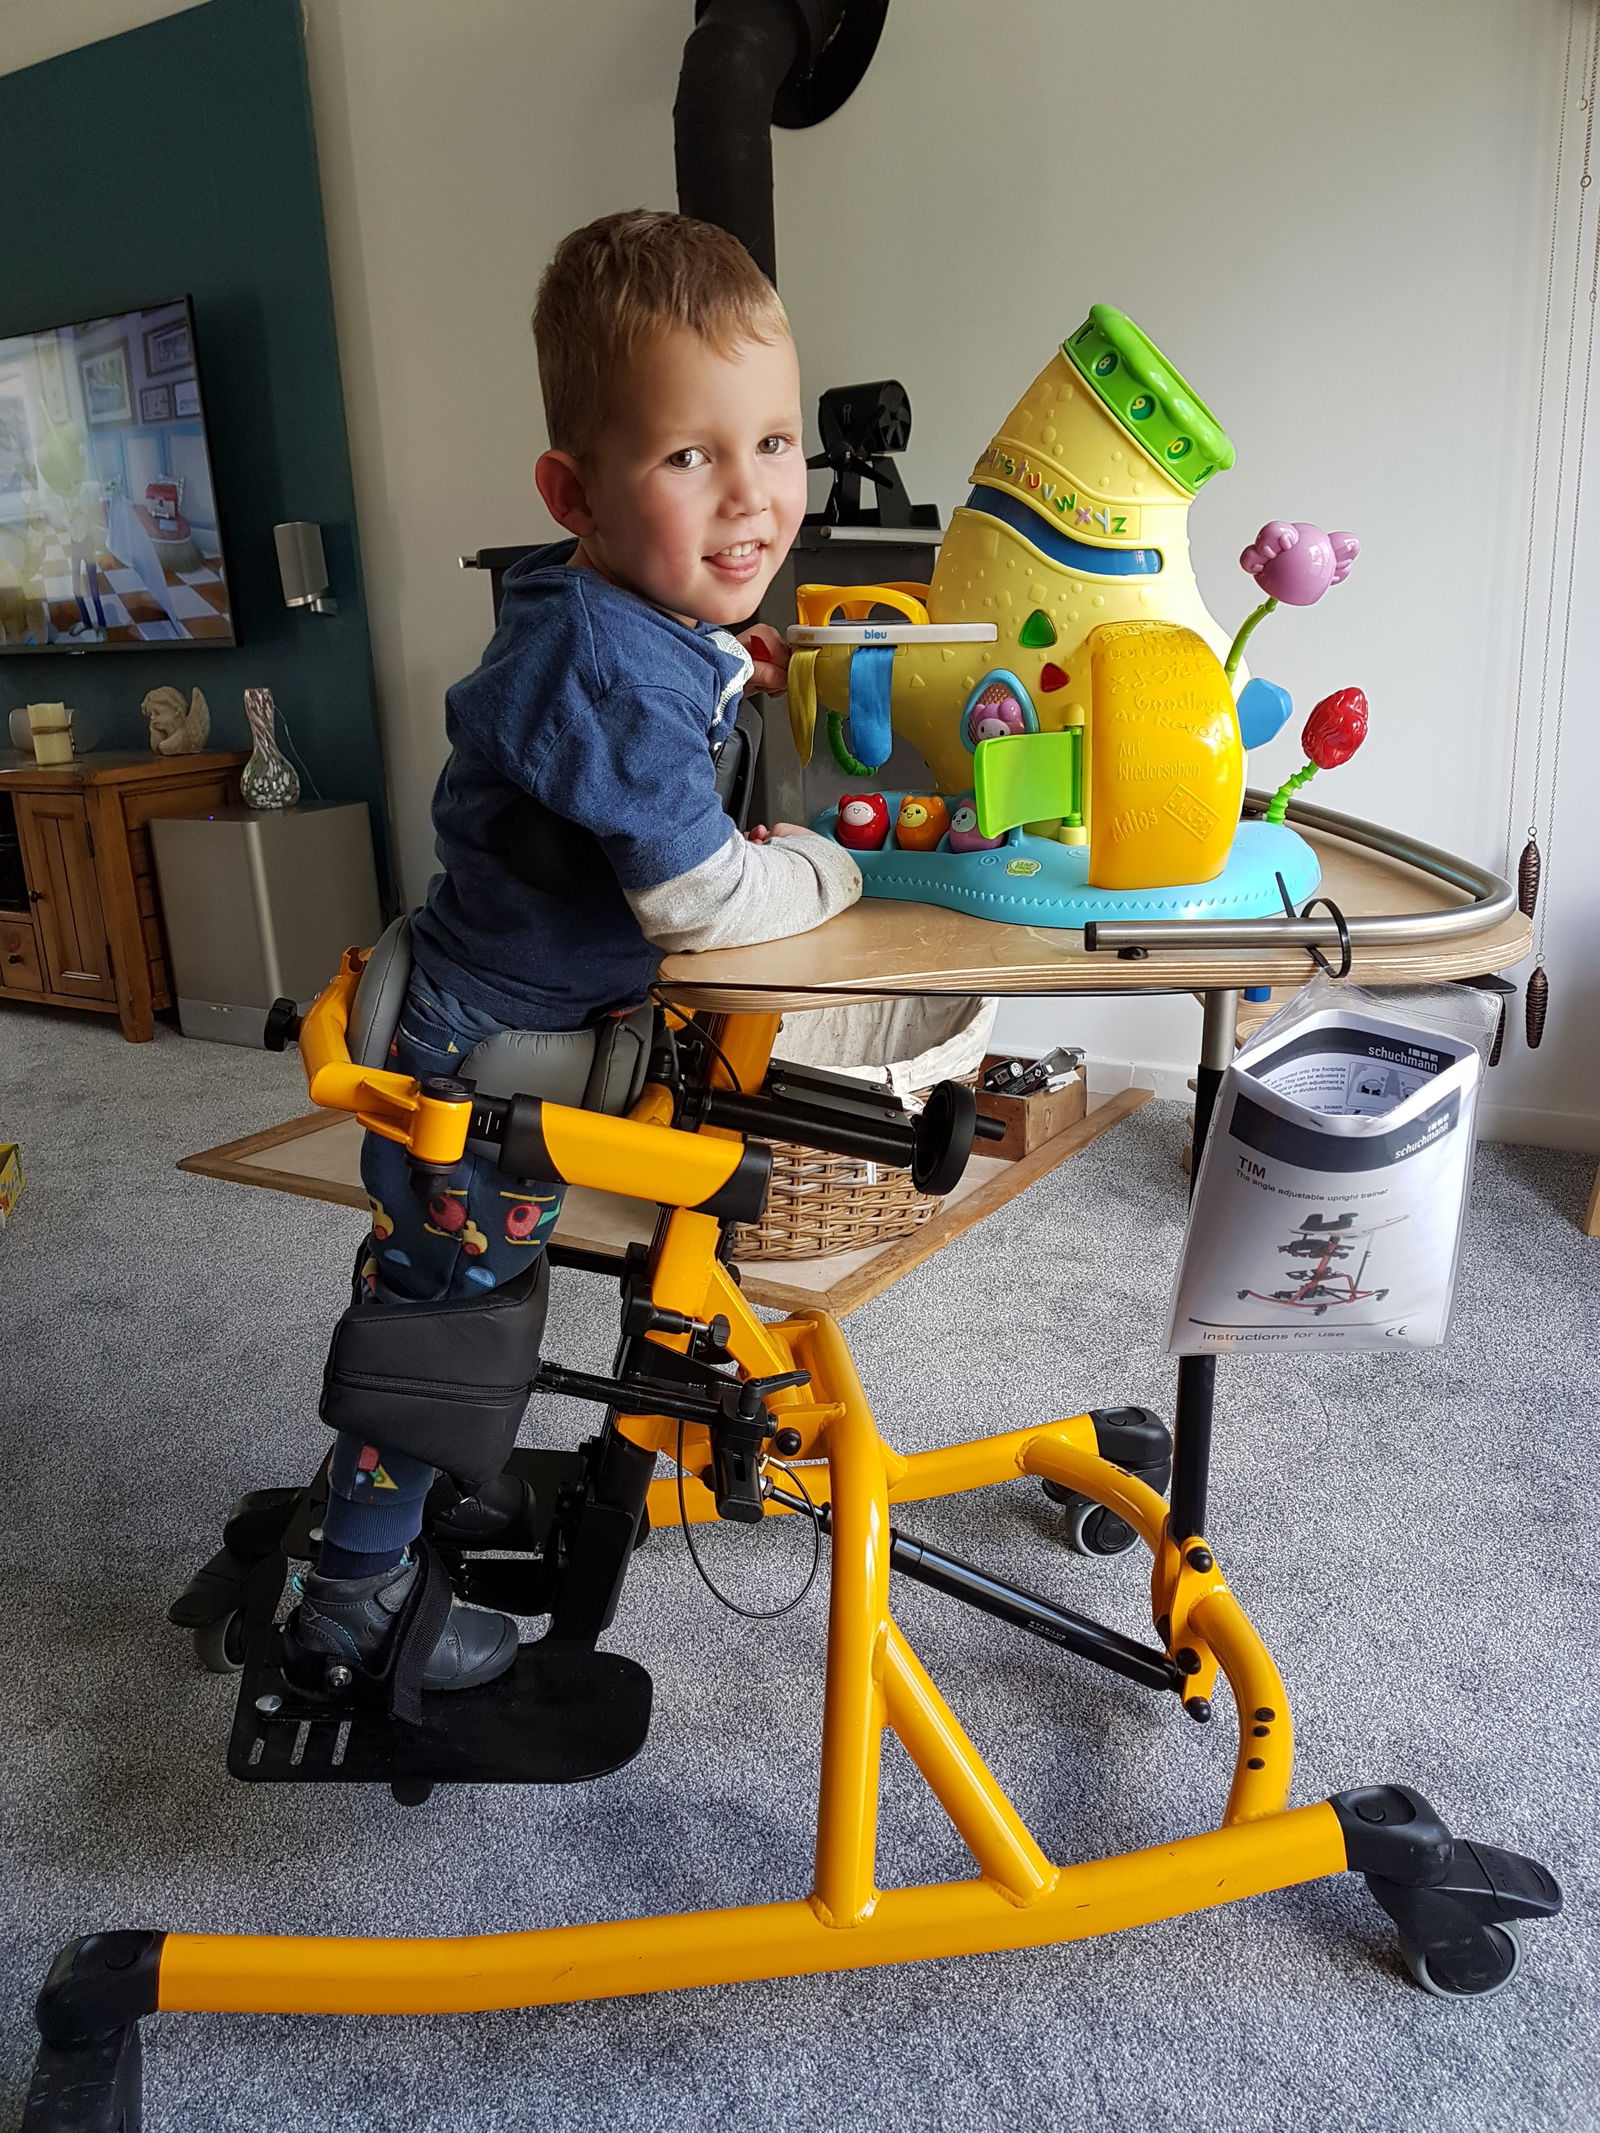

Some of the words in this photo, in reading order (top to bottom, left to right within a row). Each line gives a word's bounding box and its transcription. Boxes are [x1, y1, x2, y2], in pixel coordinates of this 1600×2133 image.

[864, 630, 887, 640] bleu
[1135, 692, 1230, 717] Goodbye
[1118, 759, 1201, 783] Wiedersehen
[1368, 1045, 1438, 1073] schuchmann
[1308, 1079, 1339, 1087] adjustment
[1315, 1072, 1339, 1080] adjusted
[1394, 1121, 1449, 1159] schuchmann
[1238, 1155, 1267, 1179] TIM
[1235, 1169, 1251, 1182] The
[1252, 1178, 1276, 1193] angle
[1277, 1187, 1325, 1201] adjustable
[1327, 1193, 1359, 1202] upright
[1360, 1188, 1389, 1200] trainer
[1202, 1331, 1289, 1342] Instructions
[1293, 1331, 1314, 1340] for
